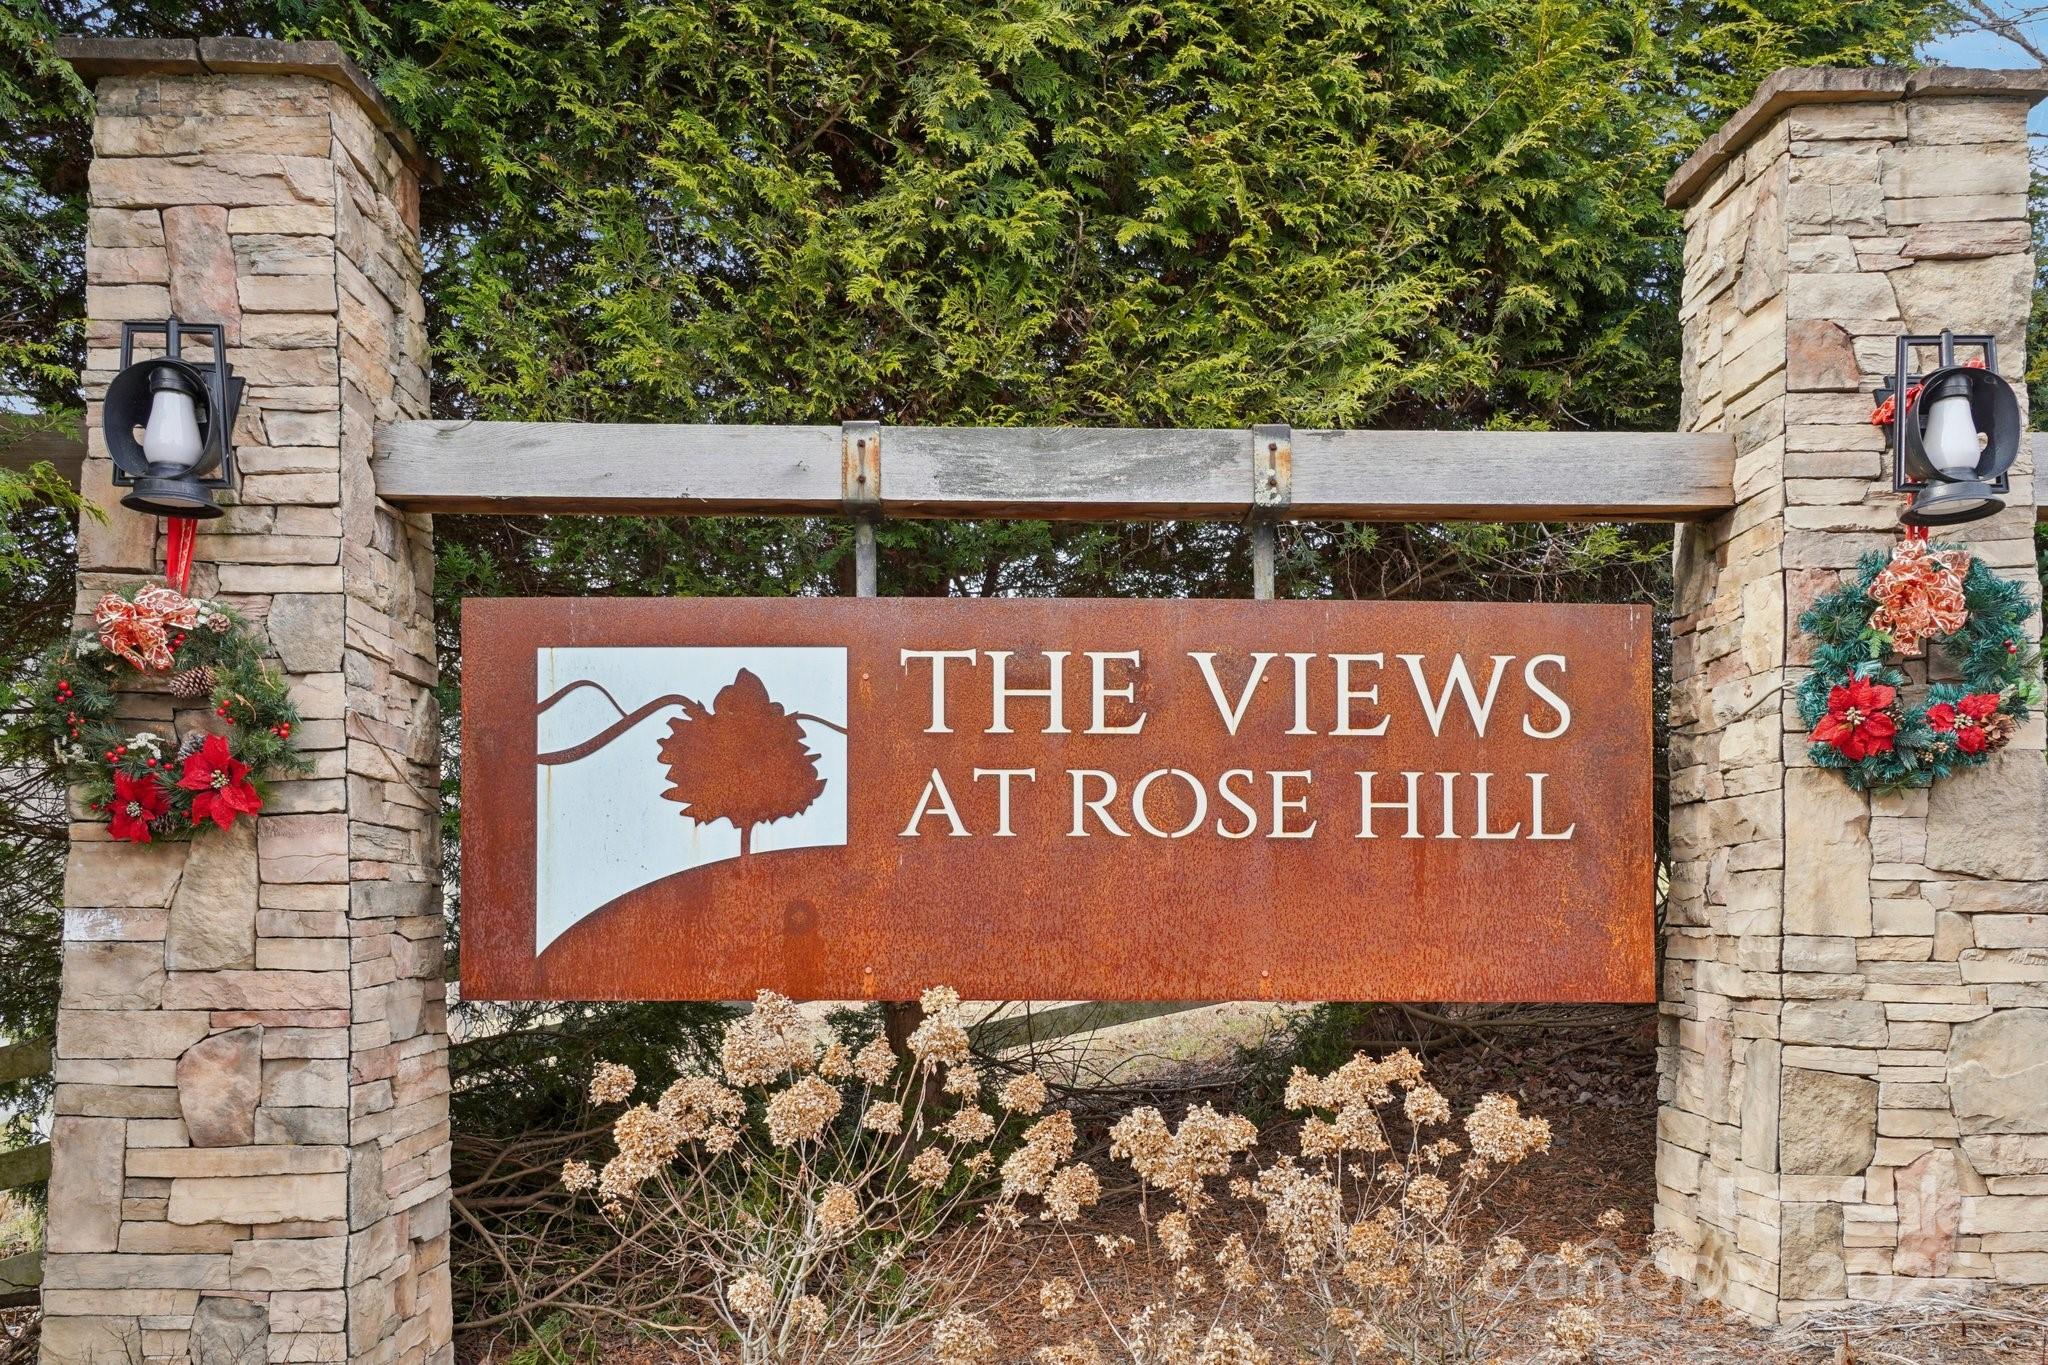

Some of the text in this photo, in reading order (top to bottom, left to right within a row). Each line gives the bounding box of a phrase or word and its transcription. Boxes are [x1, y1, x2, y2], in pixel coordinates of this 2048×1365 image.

[899, 648, 1572, 740] THE VIEWS
[899, 767, 1576, 841] AT ROSE HILL
